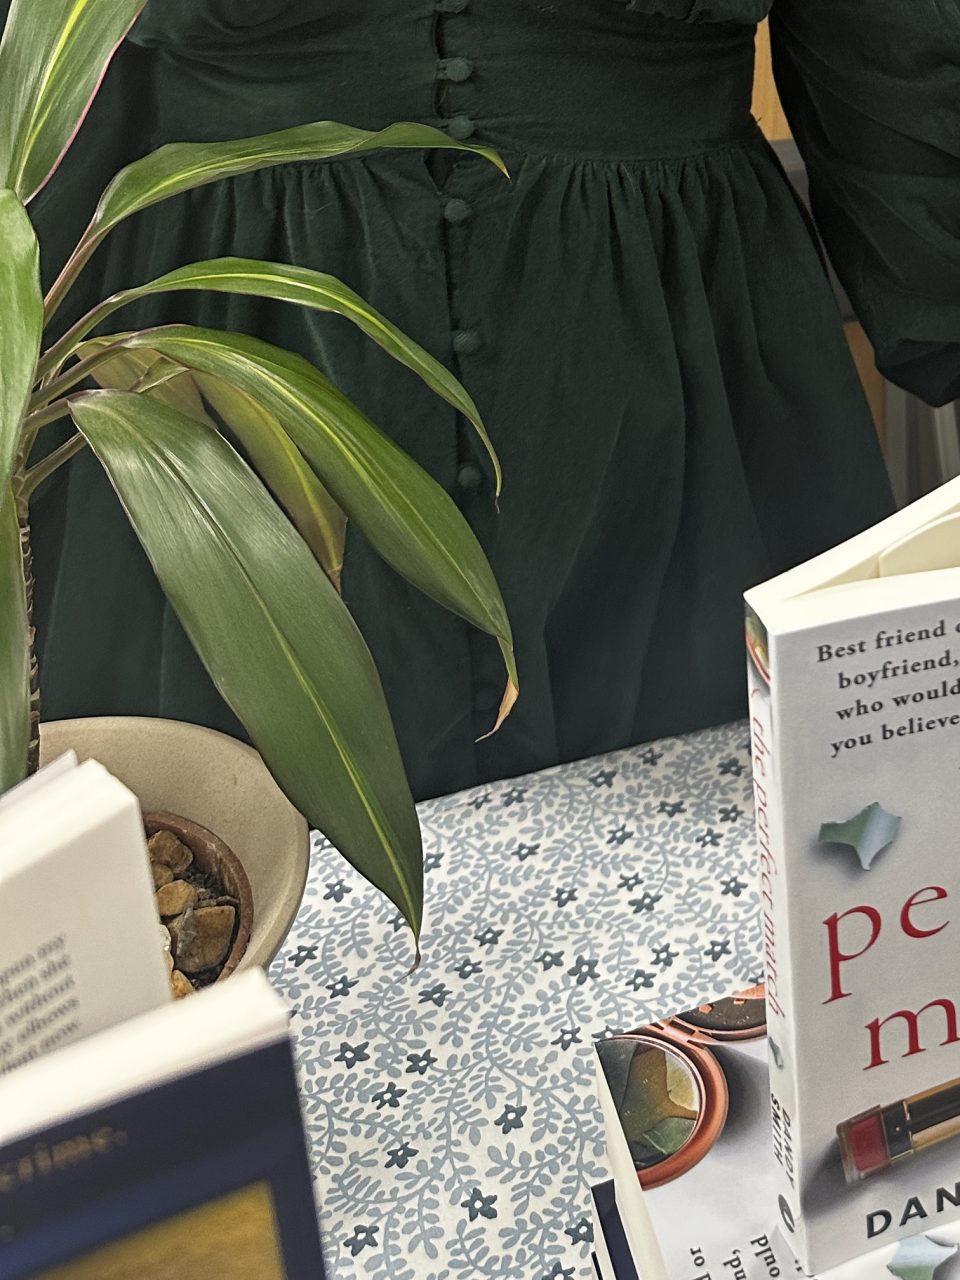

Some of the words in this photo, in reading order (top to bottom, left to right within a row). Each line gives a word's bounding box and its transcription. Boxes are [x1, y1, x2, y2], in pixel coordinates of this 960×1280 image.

[816, 639, 867, 663] Best
[875, 619, 947, 650] friend
[838, 649, 960, 689] boyfriend,
[836, 698, 884, 721] who
[752, 716, 771, 777] the
[831, 733, 873, 759] you
[752, 777, 778, 910] perfect
[764, 909, 786, 1018] match
[770, 1093, 784, 1166] SMITH
[782, 1106, 796, 1180] DANDY
[750, 1233, 781, 1280] ould
